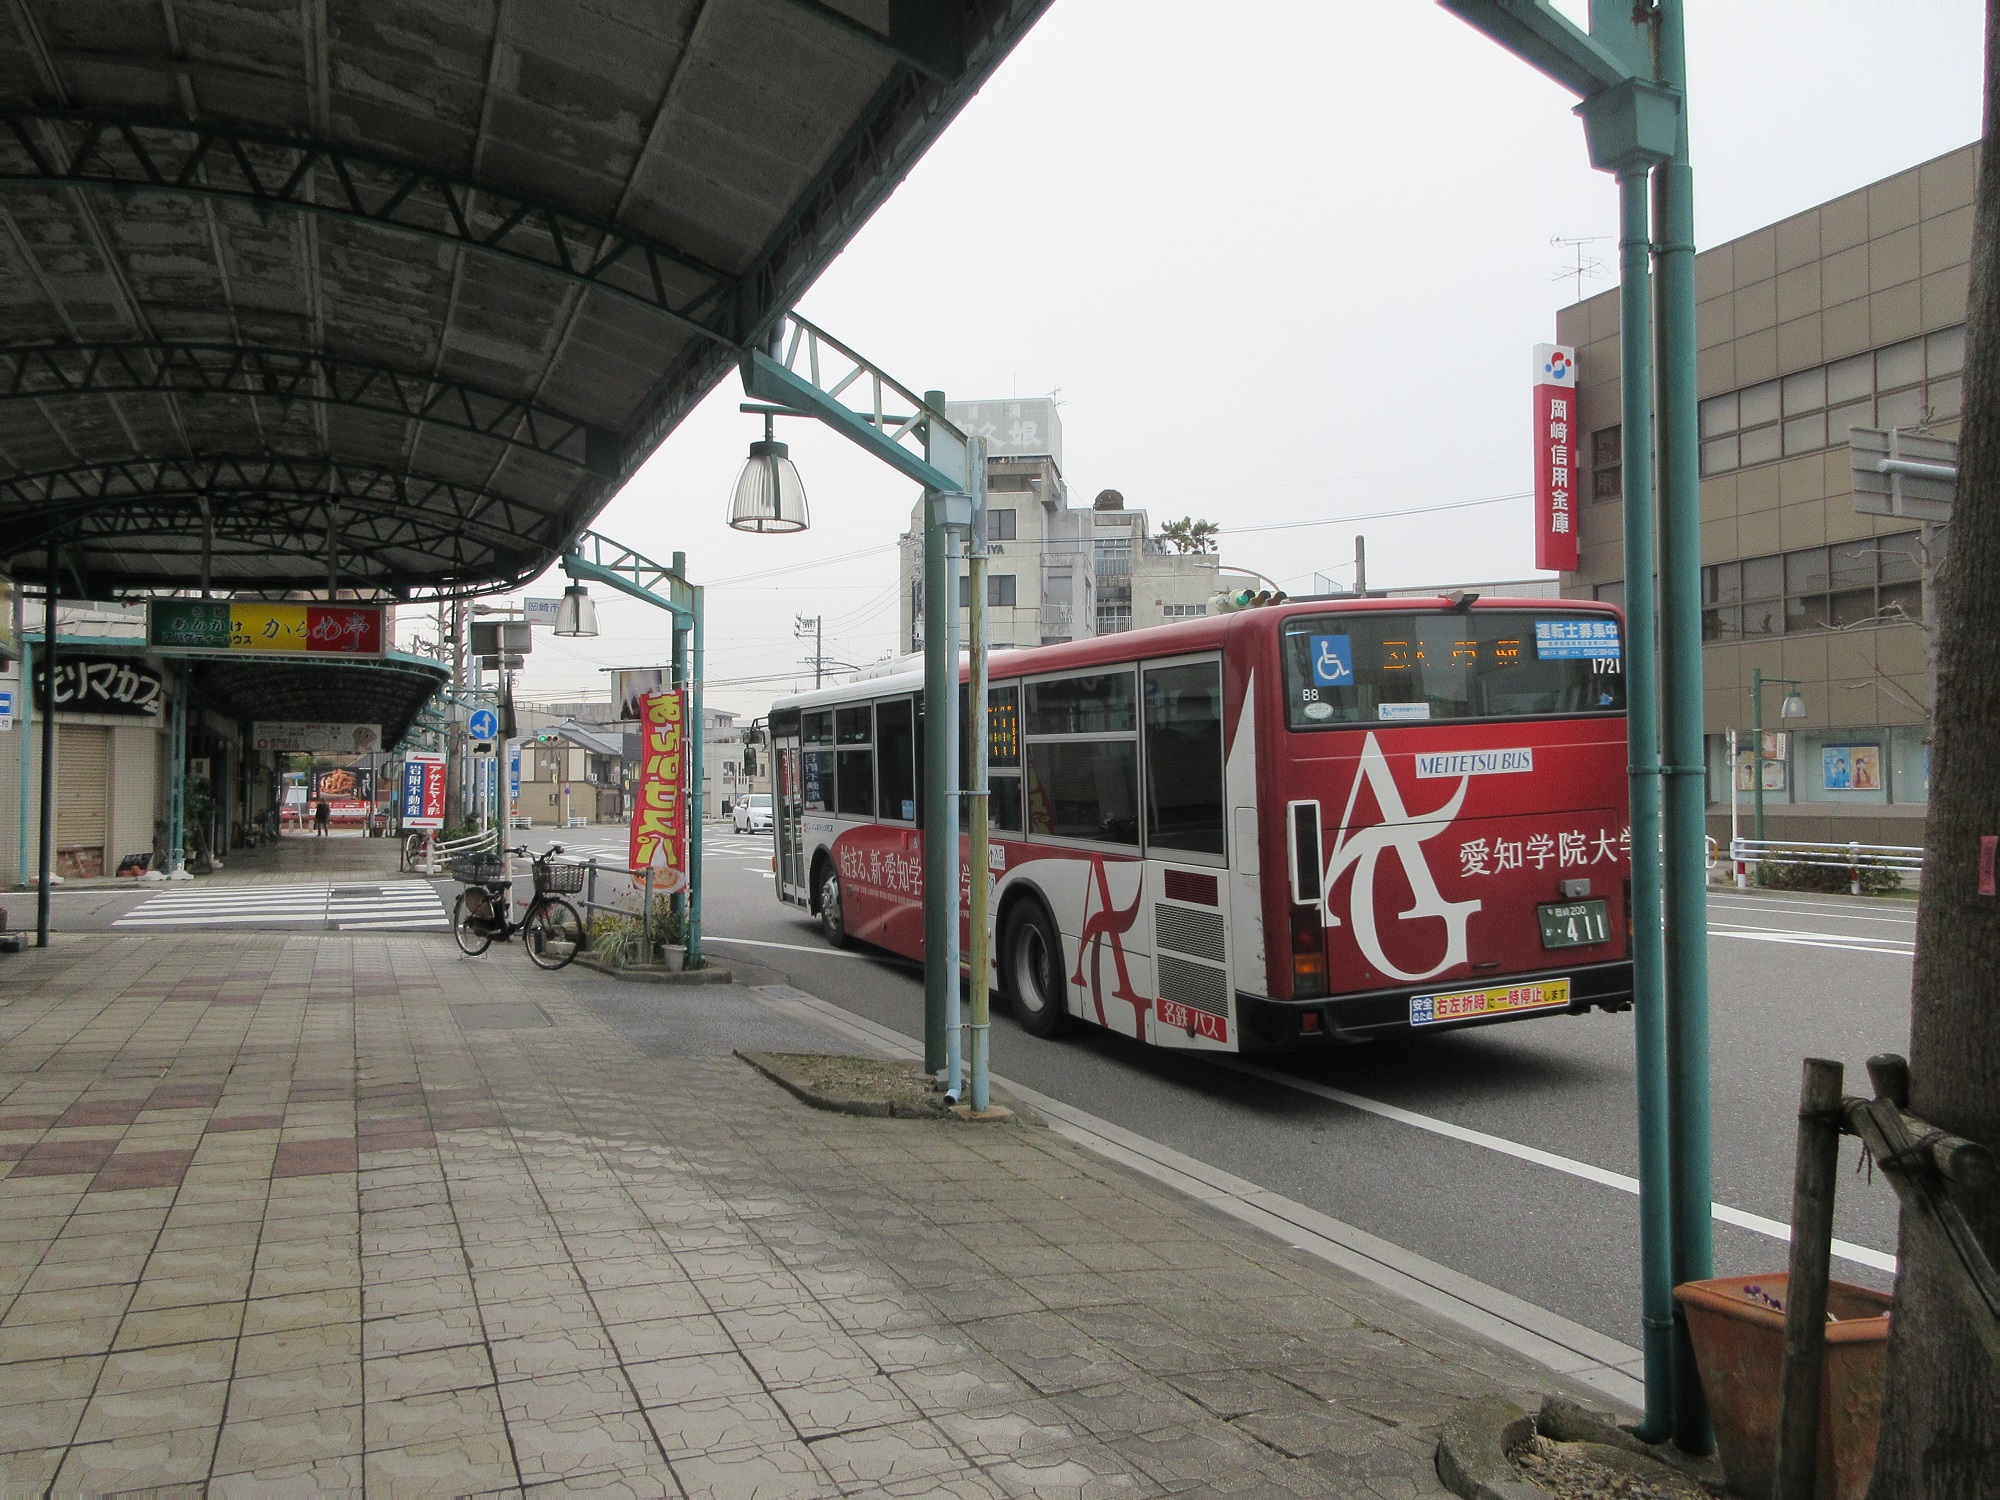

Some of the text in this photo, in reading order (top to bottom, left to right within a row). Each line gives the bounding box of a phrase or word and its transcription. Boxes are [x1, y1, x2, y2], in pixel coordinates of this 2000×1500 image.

[172, 617, 243, 632] あんかけ
[261, 612, 370, 651] からめ亭
[1535, 623, 1618, 639] 運転士募集中
[1592, 658, 1621, 674] 1721
[1302, 688, 1319, 701] B8
[1419, 751, 1531, 775] MEITETSU BUS
[407, 765, 422, 816] 岩附不動産
[427, 765, 443, 816] アサヒヤ人形
[1412, 997, 1433, 1011] 安全
[1436, 987, 1566, 1016] 右左折時に一時停止します
[1412, 1012, 1433, 1022] のため
